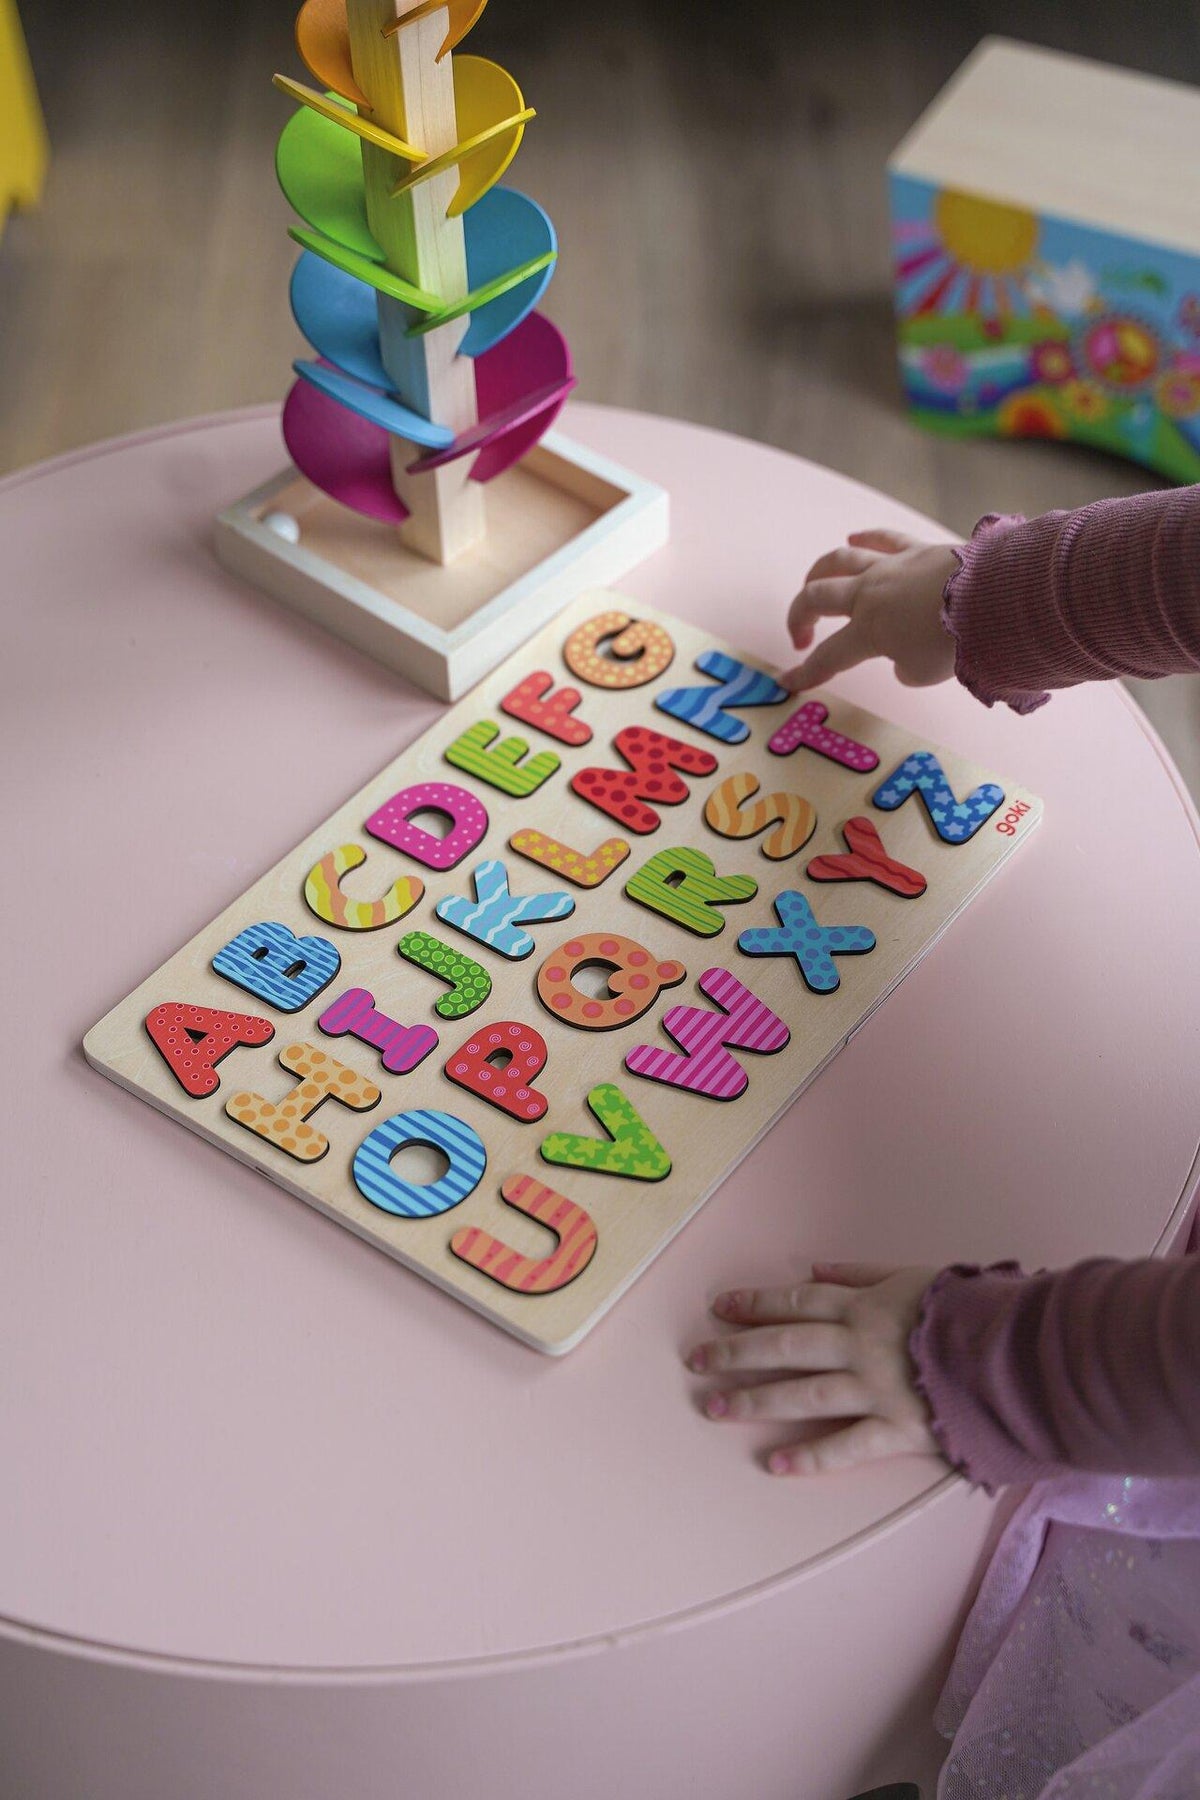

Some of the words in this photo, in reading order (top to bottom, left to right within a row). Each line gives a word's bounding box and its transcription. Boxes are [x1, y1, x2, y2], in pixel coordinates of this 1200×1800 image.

[563, 611, 675, 689] G
[500, 670, 593, 747] F
[655, 649, 790, 745] N
[444, 719, 561, 798] E
[570, 726, 718, 835] M
[365, 782, 488, 871] D
[509, 828, 631, 889] L
[996, 800, 1031, 836] goki
[303, 844, 425, 932] C
[436, 860, 575, 961] K
[212, 921, 341, 1013] B
[352, 1109, 487, 1219] O
[444, 1021, 548, 1123] P
[537, 932, 687, 1032] Q
[624, 846, 758, 938] R
[705, 771, 817, 860] S
[768, 701, 880, 773] T
[398, 931, 492, 1020] J
[145, 1001, 275, 1099] A
[318, 987, 439, 1075] I
[449, 1173, 598, 1295] U
[540, 1083, 672, 1182] V
[625, 966, 791, 1101] W
[738, 889, 876, 995] X
[807, 816, 927, 899] Y
[872, 751, 1005, 845] Z
[225, 1042, 382, 1163] H
